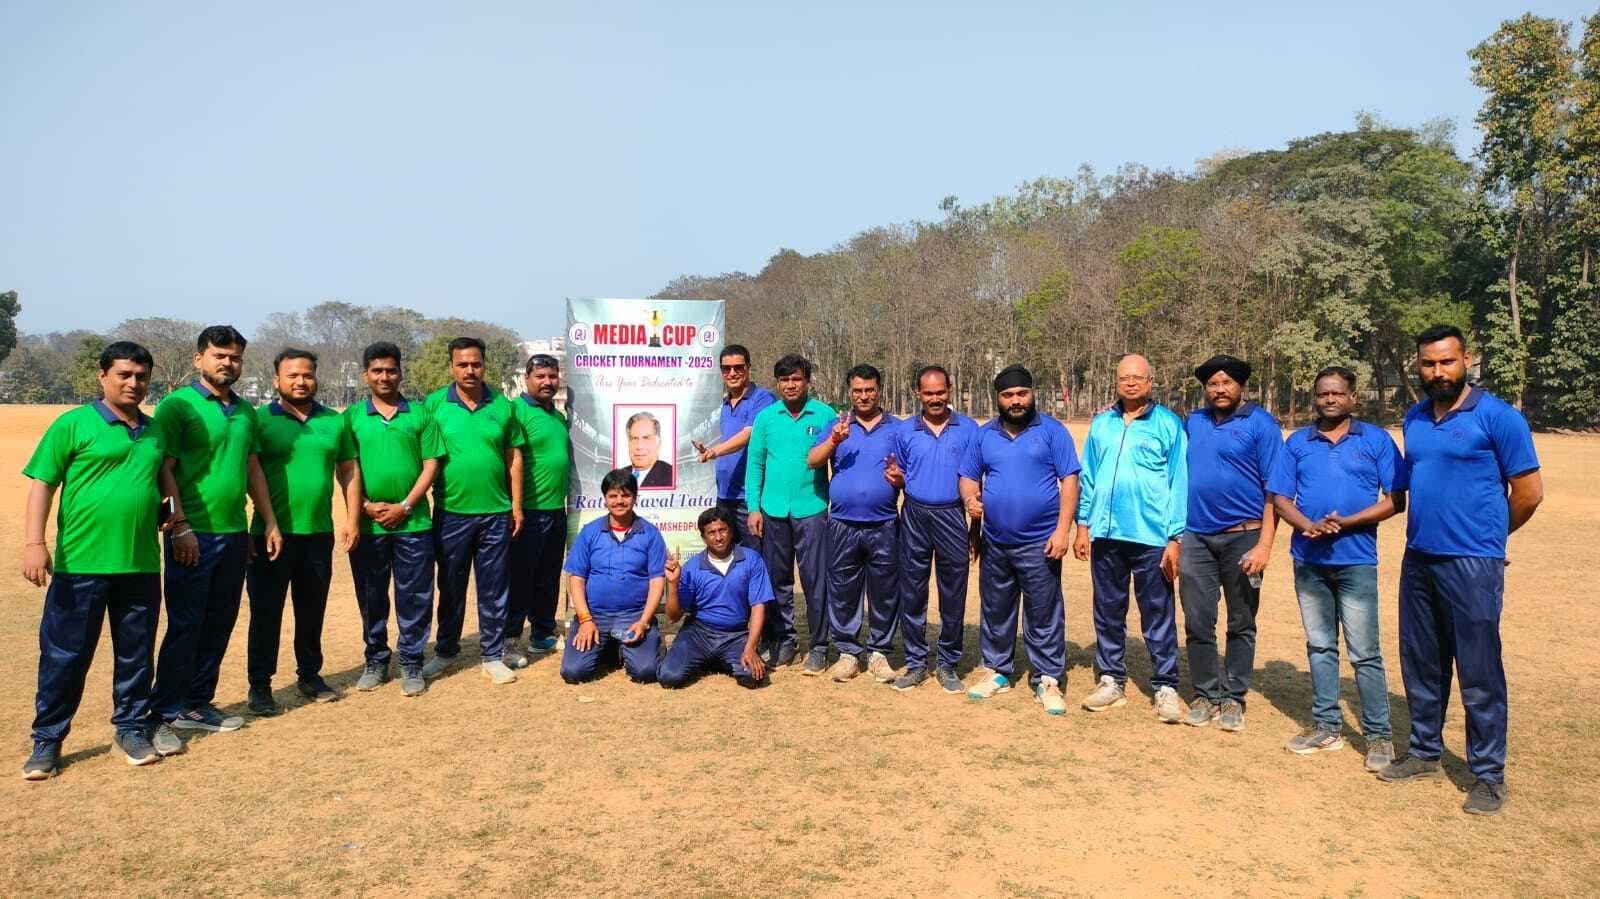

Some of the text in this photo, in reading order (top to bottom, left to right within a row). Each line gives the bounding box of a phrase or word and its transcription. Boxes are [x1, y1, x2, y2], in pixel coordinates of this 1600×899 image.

[594, 324, 647, 345] MEDIA
[662, 325, 697, 346] CUP
[576, 355, 616, 367] CRICKET
[619, 356, 682, 368] TOURNAMENT
[679, 494, 713, 507] Tata
